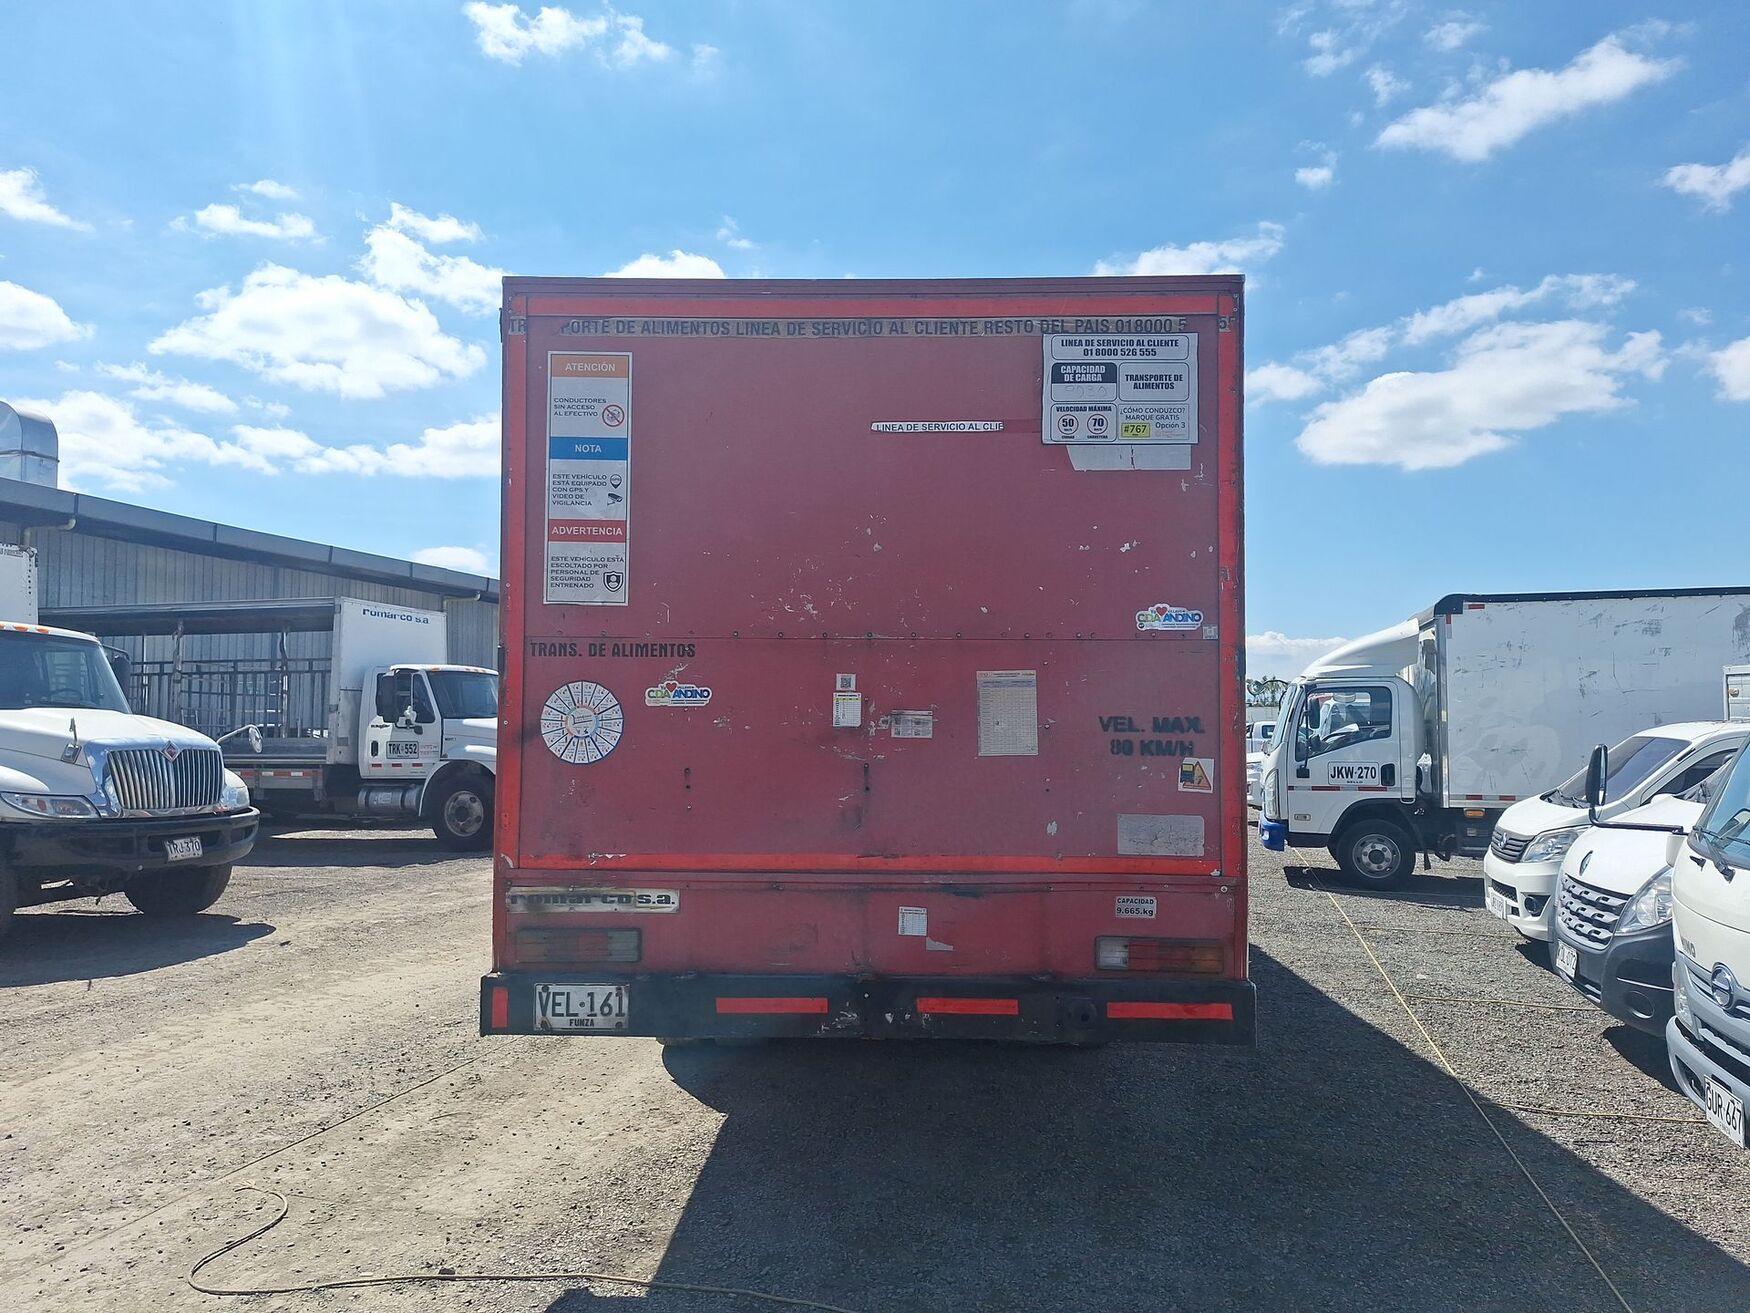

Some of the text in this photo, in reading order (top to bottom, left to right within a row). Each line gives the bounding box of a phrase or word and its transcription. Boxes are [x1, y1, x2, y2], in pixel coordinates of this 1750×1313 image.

[615, 319, 636, 334] DE
[640, 319, 730, 336] ALIMENTOS
[736, 321, 781, 336] LINEA
[786, 321, 807, 336] DE
[811, 319, 883, 336] SERVICIO
[888, 321, 909, 335] AL
[914, 320, 979, 336] CLIENTE
[984, 319, 1034, 335] RESTO
[1040, 318, 1069, 334] DEL
[1074, 318, 1110, 334] PAIS
[1115, 317, 1173, 333] 018000
[1061, 338, 1180, 348] LINEA DE SERVICIO AL CLIENTE
[1083, 348, 1157, 357] 01 8000 526 555
[565, 362, 616, 372] ATENCIÓN
[1060, 365, 1106, 374] CAPACIDAD
[1064, 373, 1103, 382] DE CARGA
[1125, 374, 1184, 382] TRANSPORTE DE
[1133, 382, 1175, 390] ALIMENTOS
[876, 423, 904, 432] LINEA
[906, 423, 919, 431] DE
[921, 422, 966, 431] SERVICIO
[967, 422, 981, 431] AL
[1062, 418, 1105, 428] 50 70
[1155, 421, 1186, 430] Opción 3
[1124, 424, 1147, 433] #767
[575, 444, 602, 453] NOTA
[551, 526, 623, 536] ADVERTENCIA
[1162, 612, 1202, 623] ANDINO
[530, 642, 696, 658] TRANS. DE ALIMENTOS
[672, 688, 711, 699] ANDINO
[1098, 715, 1146, 732] VEL.
[1117, 897, 1155, 905] CAPACIDAD
[569, 1018, 595, 1027] FUNZA
